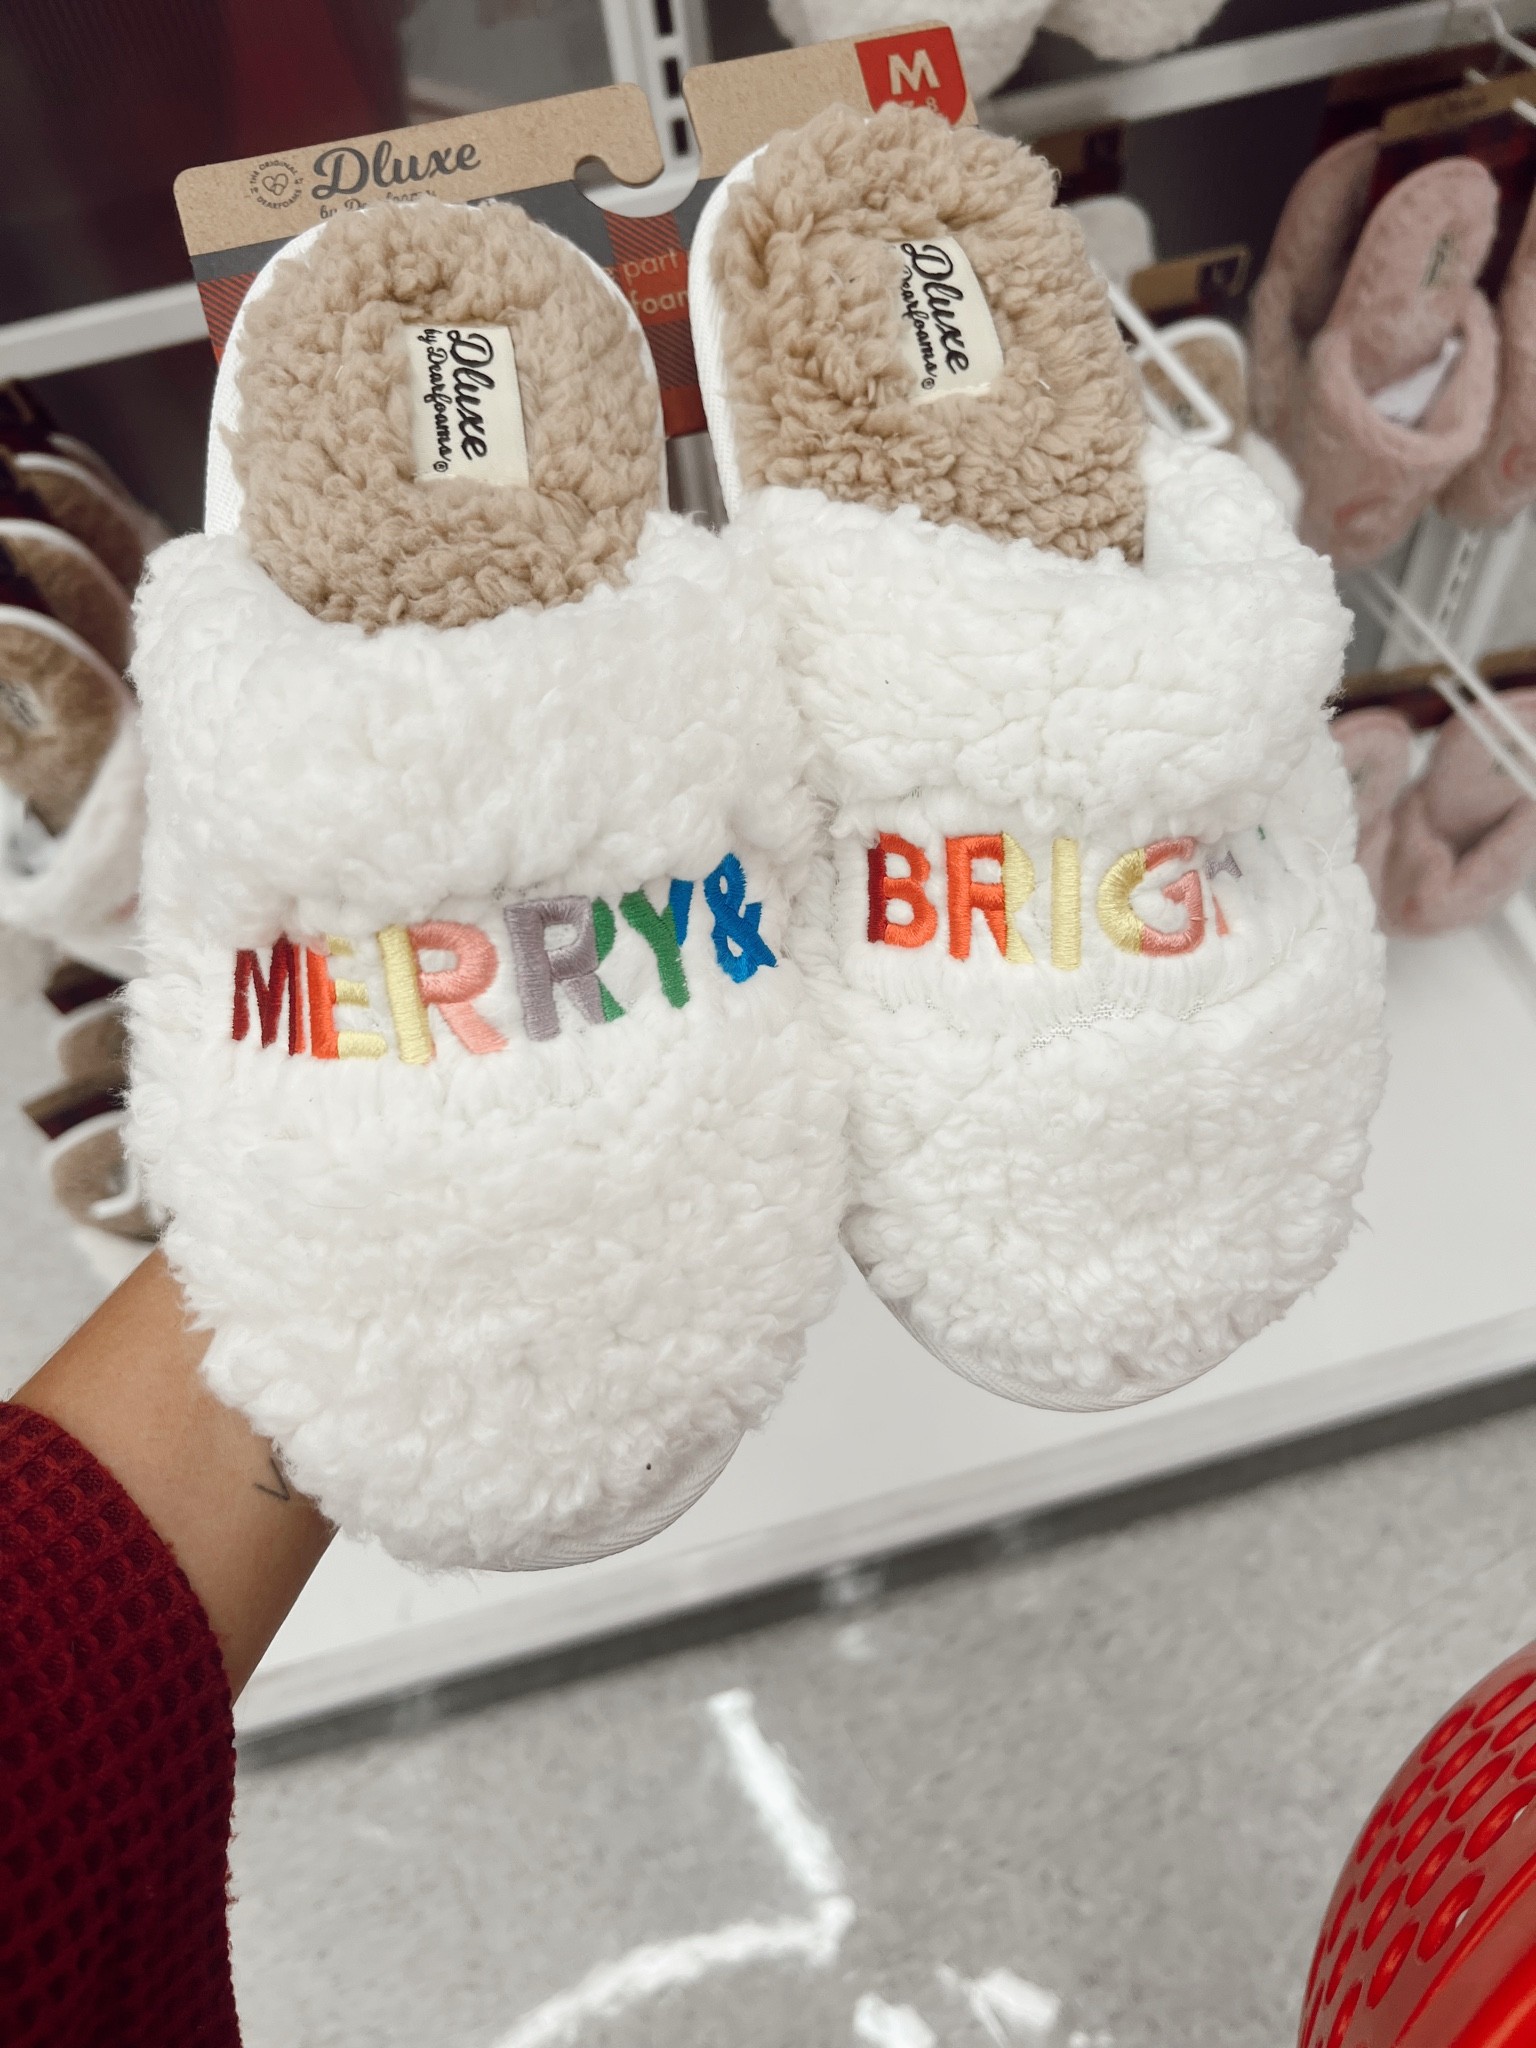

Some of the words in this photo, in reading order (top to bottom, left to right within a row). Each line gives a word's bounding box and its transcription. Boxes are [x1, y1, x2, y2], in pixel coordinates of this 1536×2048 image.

[887, 48, 941, 95] M
[311, 140, 481, 200] Dluxe
[623, 247, 678, 287] part
[417, 328, 443, 345] by
[900, 243, 969, 375] Dluxe
[447, 330, 495, 460] Dluxe
[867, 825, 1266, 971] BRIG
